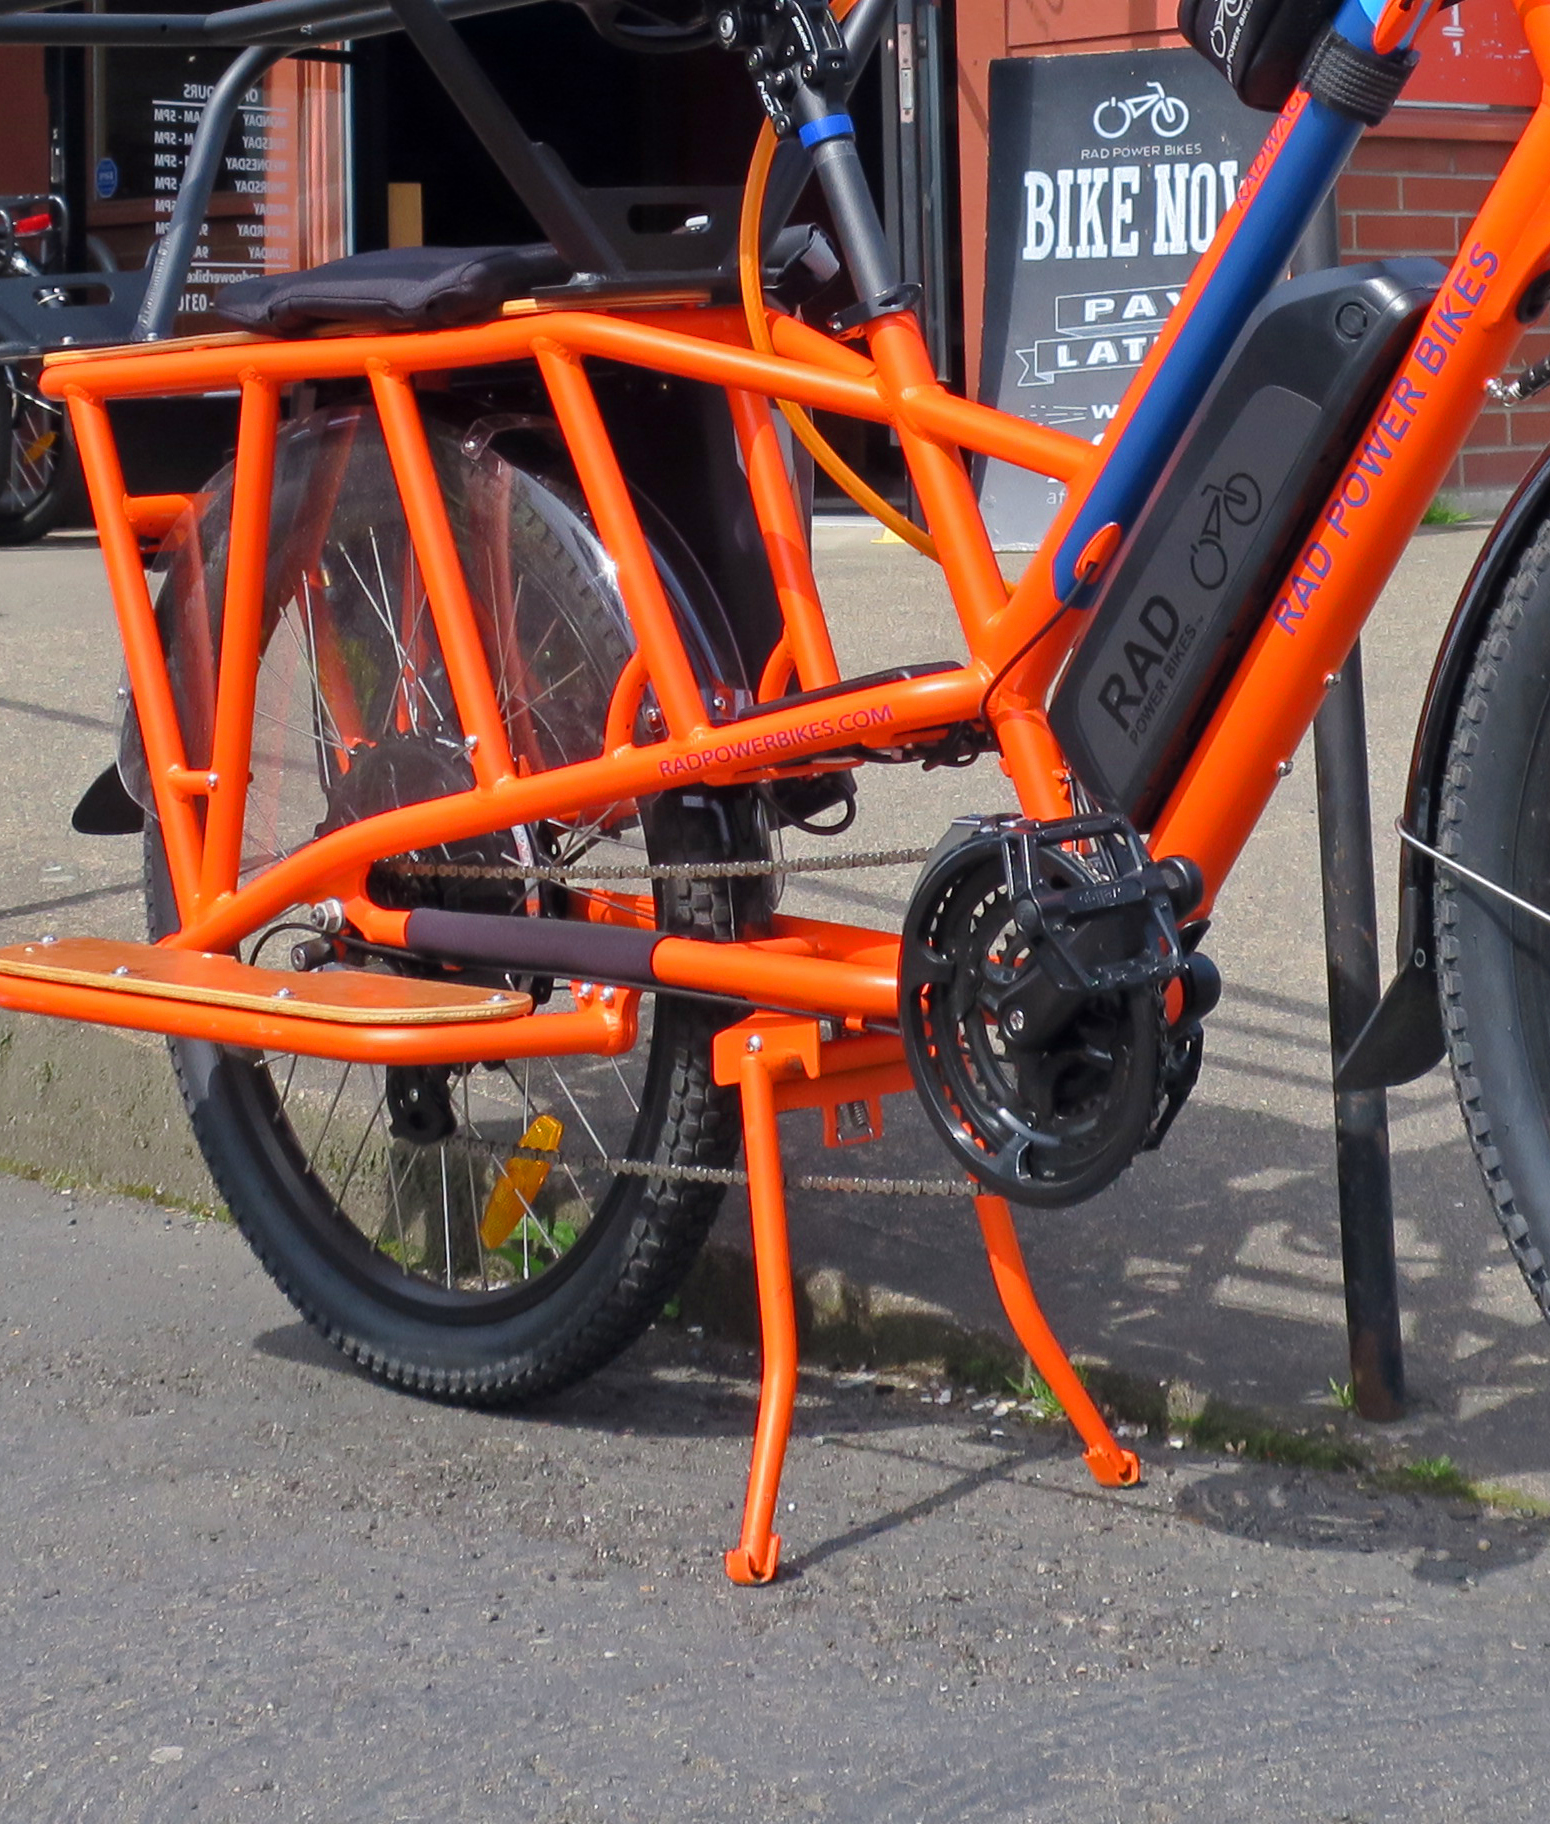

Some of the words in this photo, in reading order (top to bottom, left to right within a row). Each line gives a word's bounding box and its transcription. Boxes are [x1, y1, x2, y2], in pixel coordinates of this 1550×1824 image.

[1226, 25, 1242, 65] POWER
[1080, 148, 1110, 161] RAD
[1112, 144, 1161, 159] POWER
[1164, 142, 1203, 157] BIKES
[1022, 164, 1141, 262] BIKE
[1056, 335, 1160, 368] LAT
[1273, 541, 1335, 637] RAD
[1325, 375, 1427, 540] POWER
[1414, 242, 1499, 377] BIKES
[1097, 594, 1180, 733] RAD
[1128, 678, 1168, 746] POWER
[1162, 623, 1197, 679] BIKES
[658, 703, 895, 778] RADPOWERBIKES.COM
